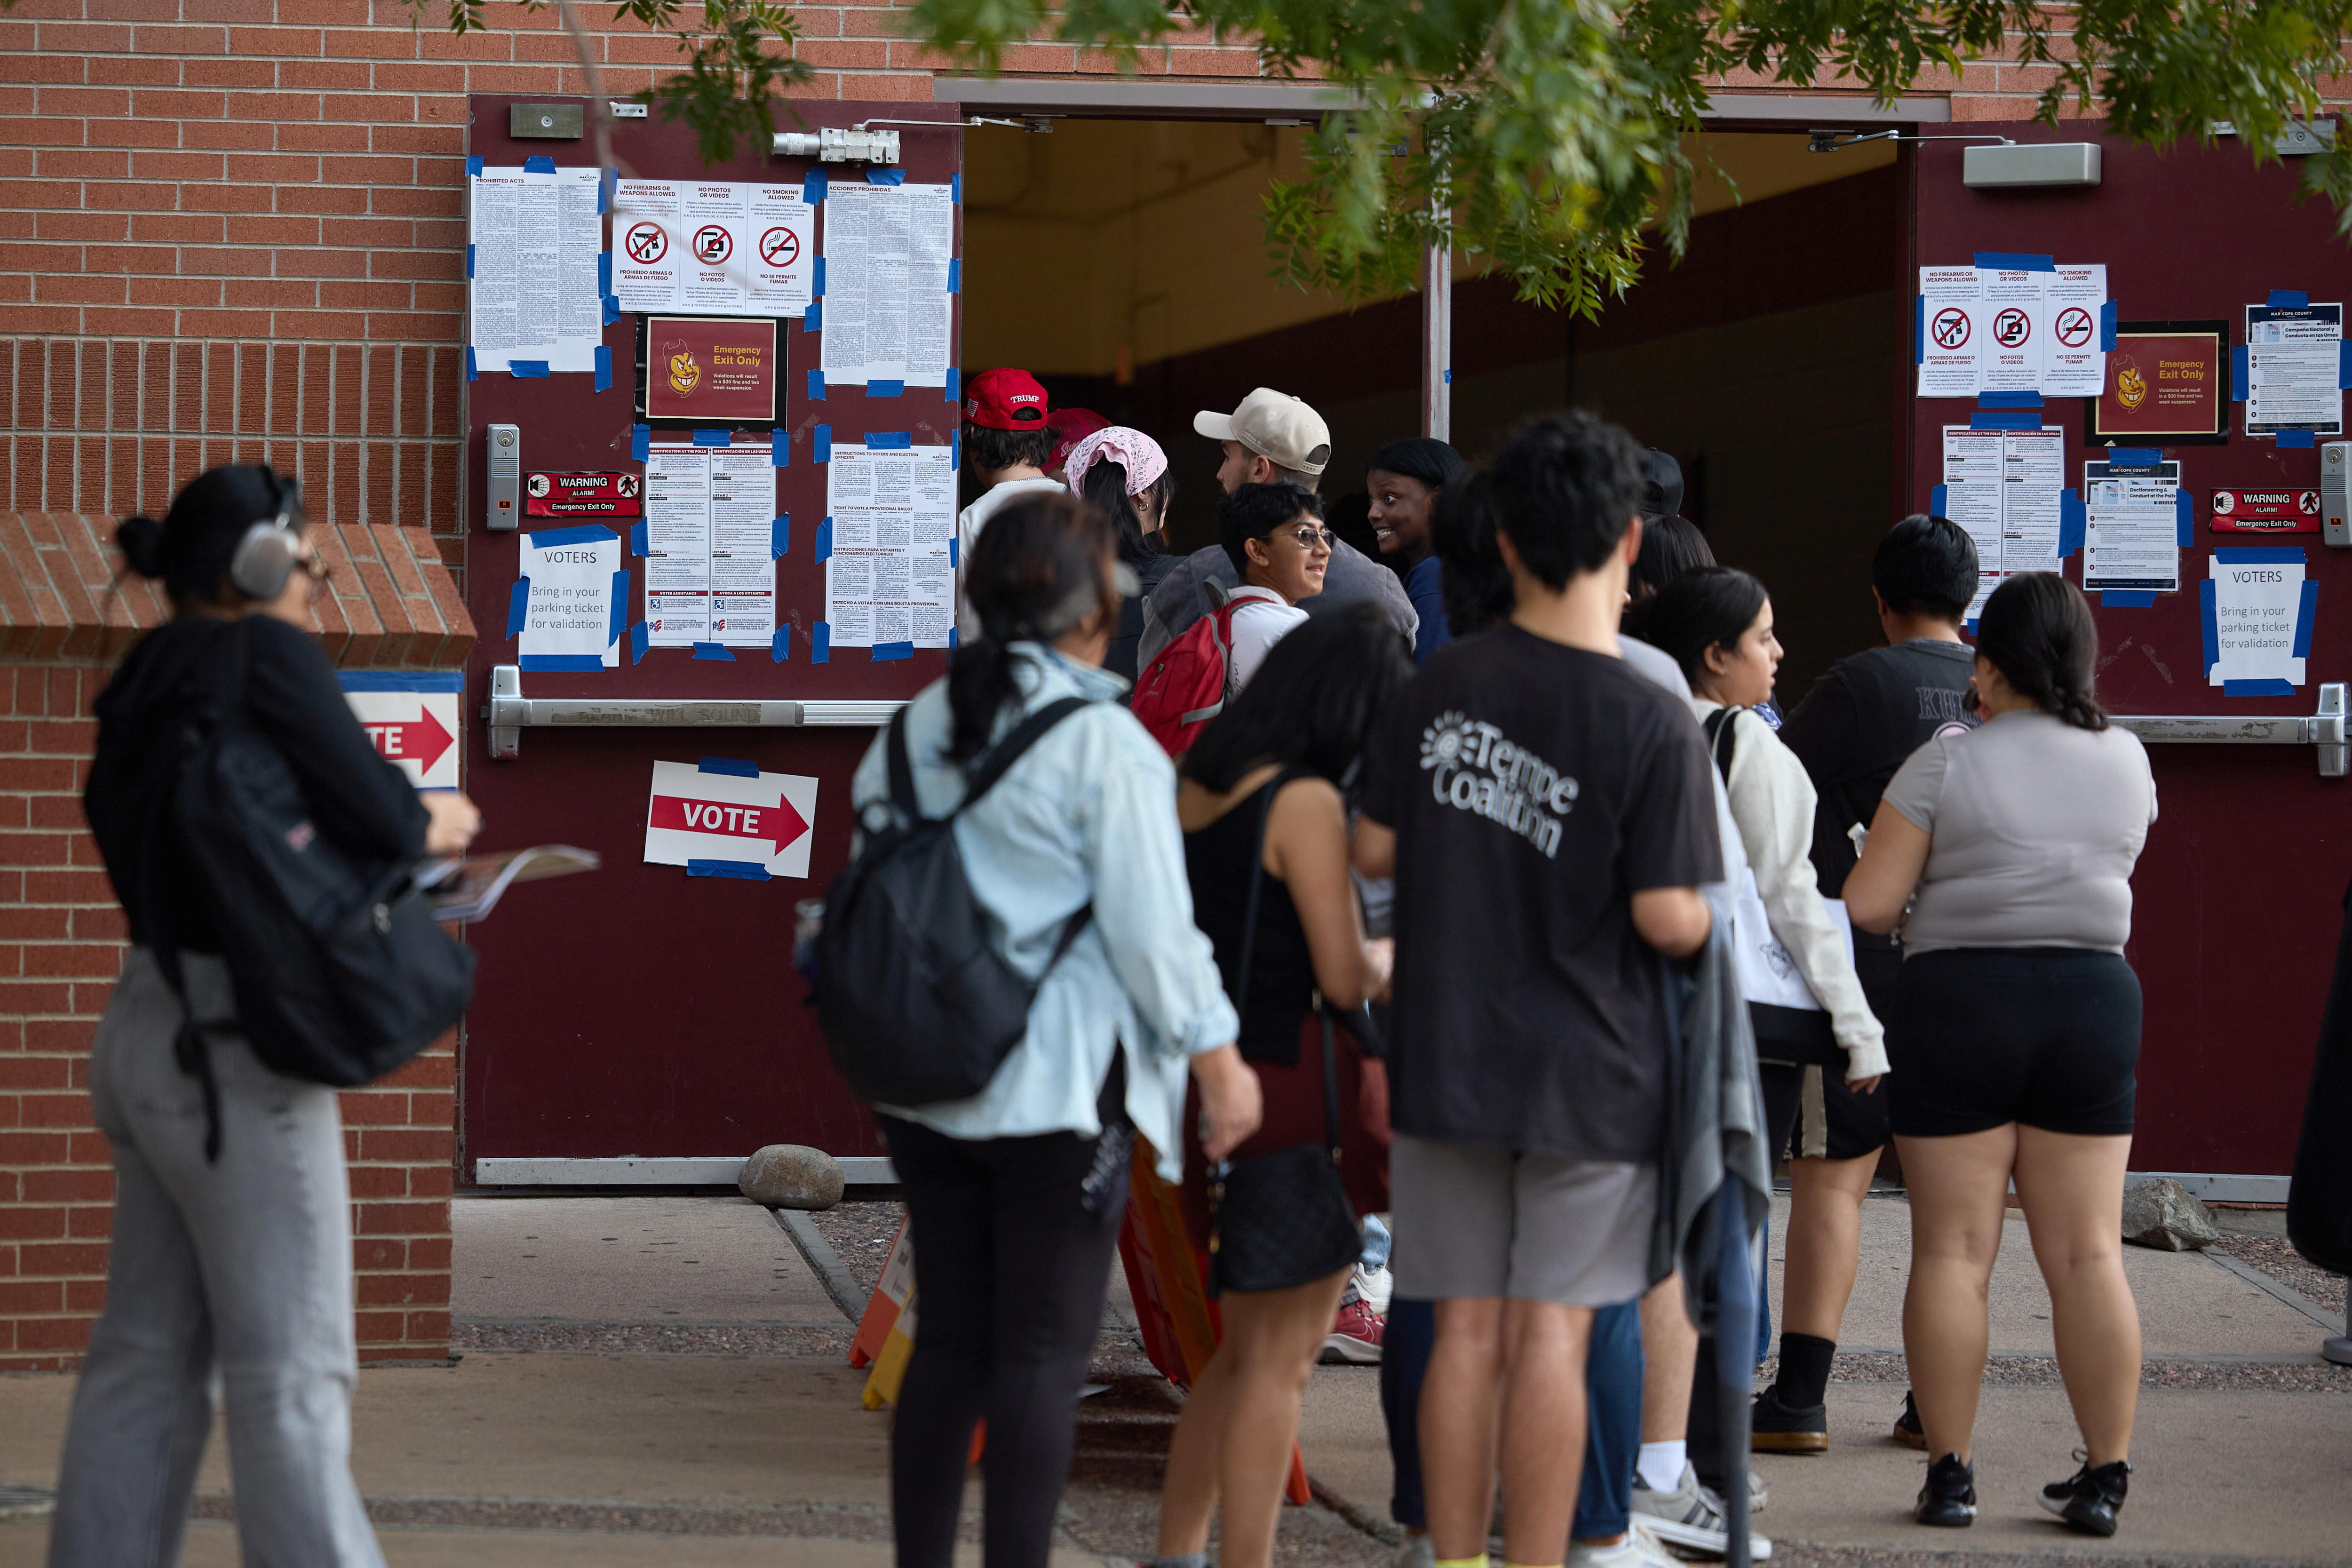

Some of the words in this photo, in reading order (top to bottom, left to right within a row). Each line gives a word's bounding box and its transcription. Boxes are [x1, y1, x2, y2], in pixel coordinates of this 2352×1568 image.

[714, 346, 761, 355] Emergency
[737, 357, 761, 367] Only
[2181, 371, 2204, 381] Only
[1010, 395, 1039, 403] TRUMP
[560, 478, 608, 487] WARNING
[2243, 494, 2290, 503] WARNING
[544, 552, 596, 564] VOTERS
[2233, 571, 2282, 582] VOTERS
[532, 587, 559, 598] Bring
[563, 587, 572, 596] in
[575, 589, 599, 598] your
[532, 604, 571, 614] parking
[574, 604, 604, 613] ticket
[2221, 607, 2247, 617] Bring
[2250, 607, 2259, 616] in
[2262, 609, 2285, 617] your
[532, 619, 546, 629] for
[550, 620, 602, 629] validation
[2221, 622, 2258, 634] parking
[2262, 622, 2290, 631] ticket
[2221, 638, 2235, 648] for
[2238, 639, 2288, 648] validation
[364, 726, 403, 755] TE
[1474, 720, 1580, 815] Tempe
[1433, 759, 1564, 860] Coalition
[683, 803, 761, 834] VOTE
